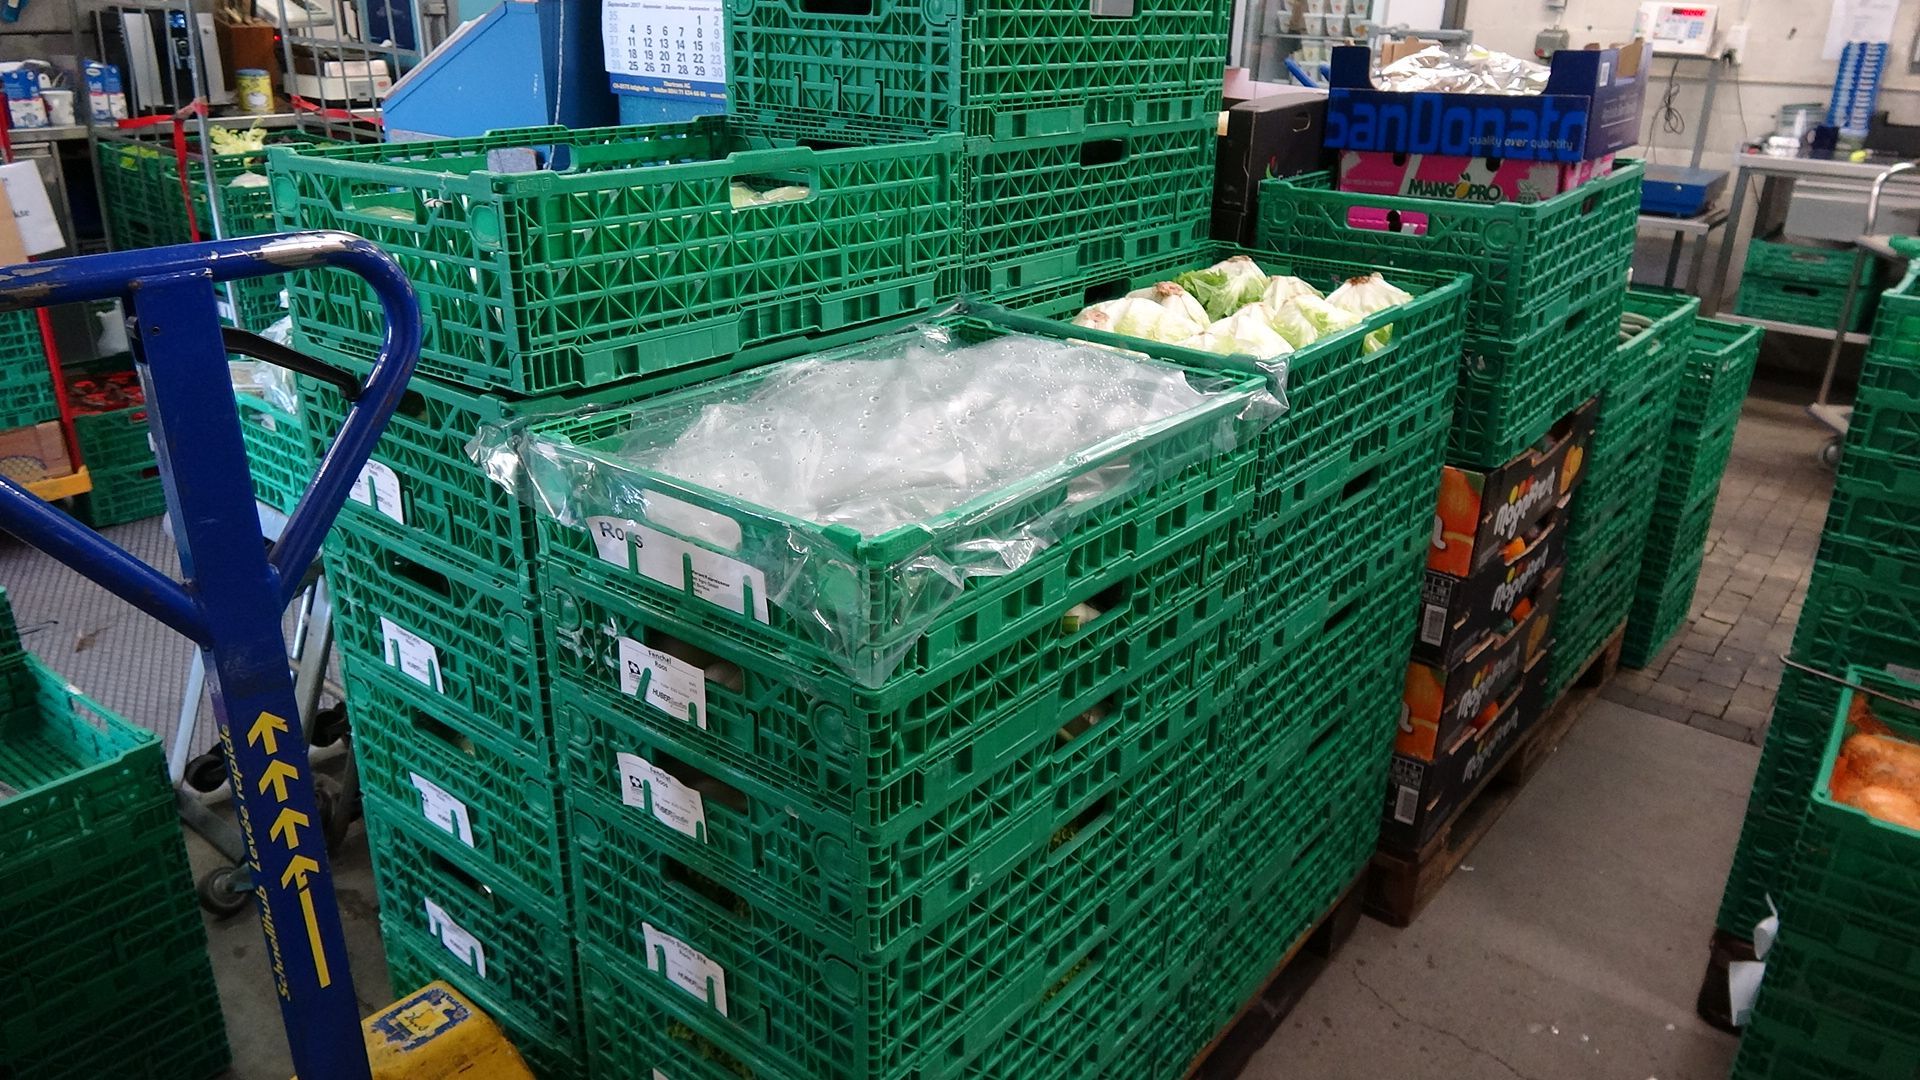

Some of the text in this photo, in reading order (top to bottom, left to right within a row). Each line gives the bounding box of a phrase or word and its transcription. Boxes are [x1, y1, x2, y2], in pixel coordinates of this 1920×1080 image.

[713, 15, 719, 26] 2
[630, 24, 635, 34] 4
[647, 25, 652, 35] 5
[662, 25, 668, 36] 6
[678, 26, 684, 37] 7
[696, 27, 702, 38] 8
[714, 28, 719, 39] 9
[628, 36, 635, 46] 11
[643, 37, 652, 48] 12
[659, 38, 669, 49] 13
[676, 39, 685, 50] 14
[693, 40, 703, 51] 15
[711, 41, 720, 52] 16
[628, 48, 637, 59] 18
[644, 49, 653, 60] 19
[659, 50, 670, 61] 20
[676, 51, 686, 62] 21
[692, 52, 703, 63] 22
[710, 54, 721, 65] 23
[628, 60, 638, 71] 25
[644, 61, 655, 72] 26
[661, 63, 671, 73] 27
[677, 64, 689, 75] 28
[694, 65, 705, 76] 29
[711, 66, 723, 77] 30
[1469, 135, 1573, 151] quality over quantity
[220, 723, 245, 800] rapide
[256, 885, 291, 1002] Schnellhub
